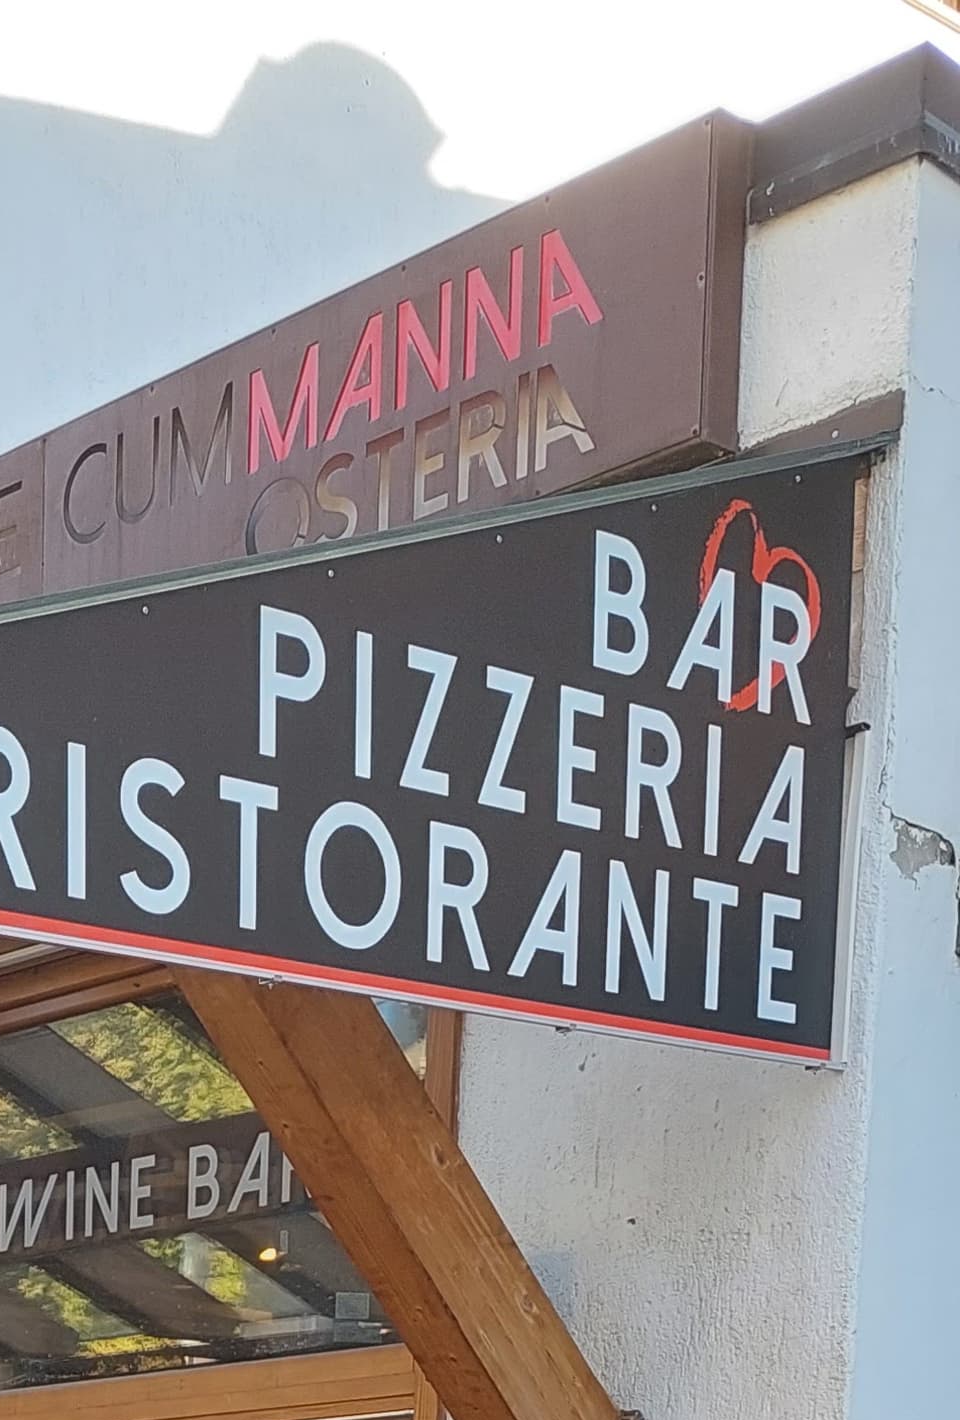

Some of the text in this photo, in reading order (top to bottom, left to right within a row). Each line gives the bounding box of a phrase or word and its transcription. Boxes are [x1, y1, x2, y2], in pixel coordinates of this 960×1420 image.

[244, 363, 595, 557] OSTERIA
[592, 528, 812, 726] BAR
[257, 603, 807, 875] PIZZERIA
